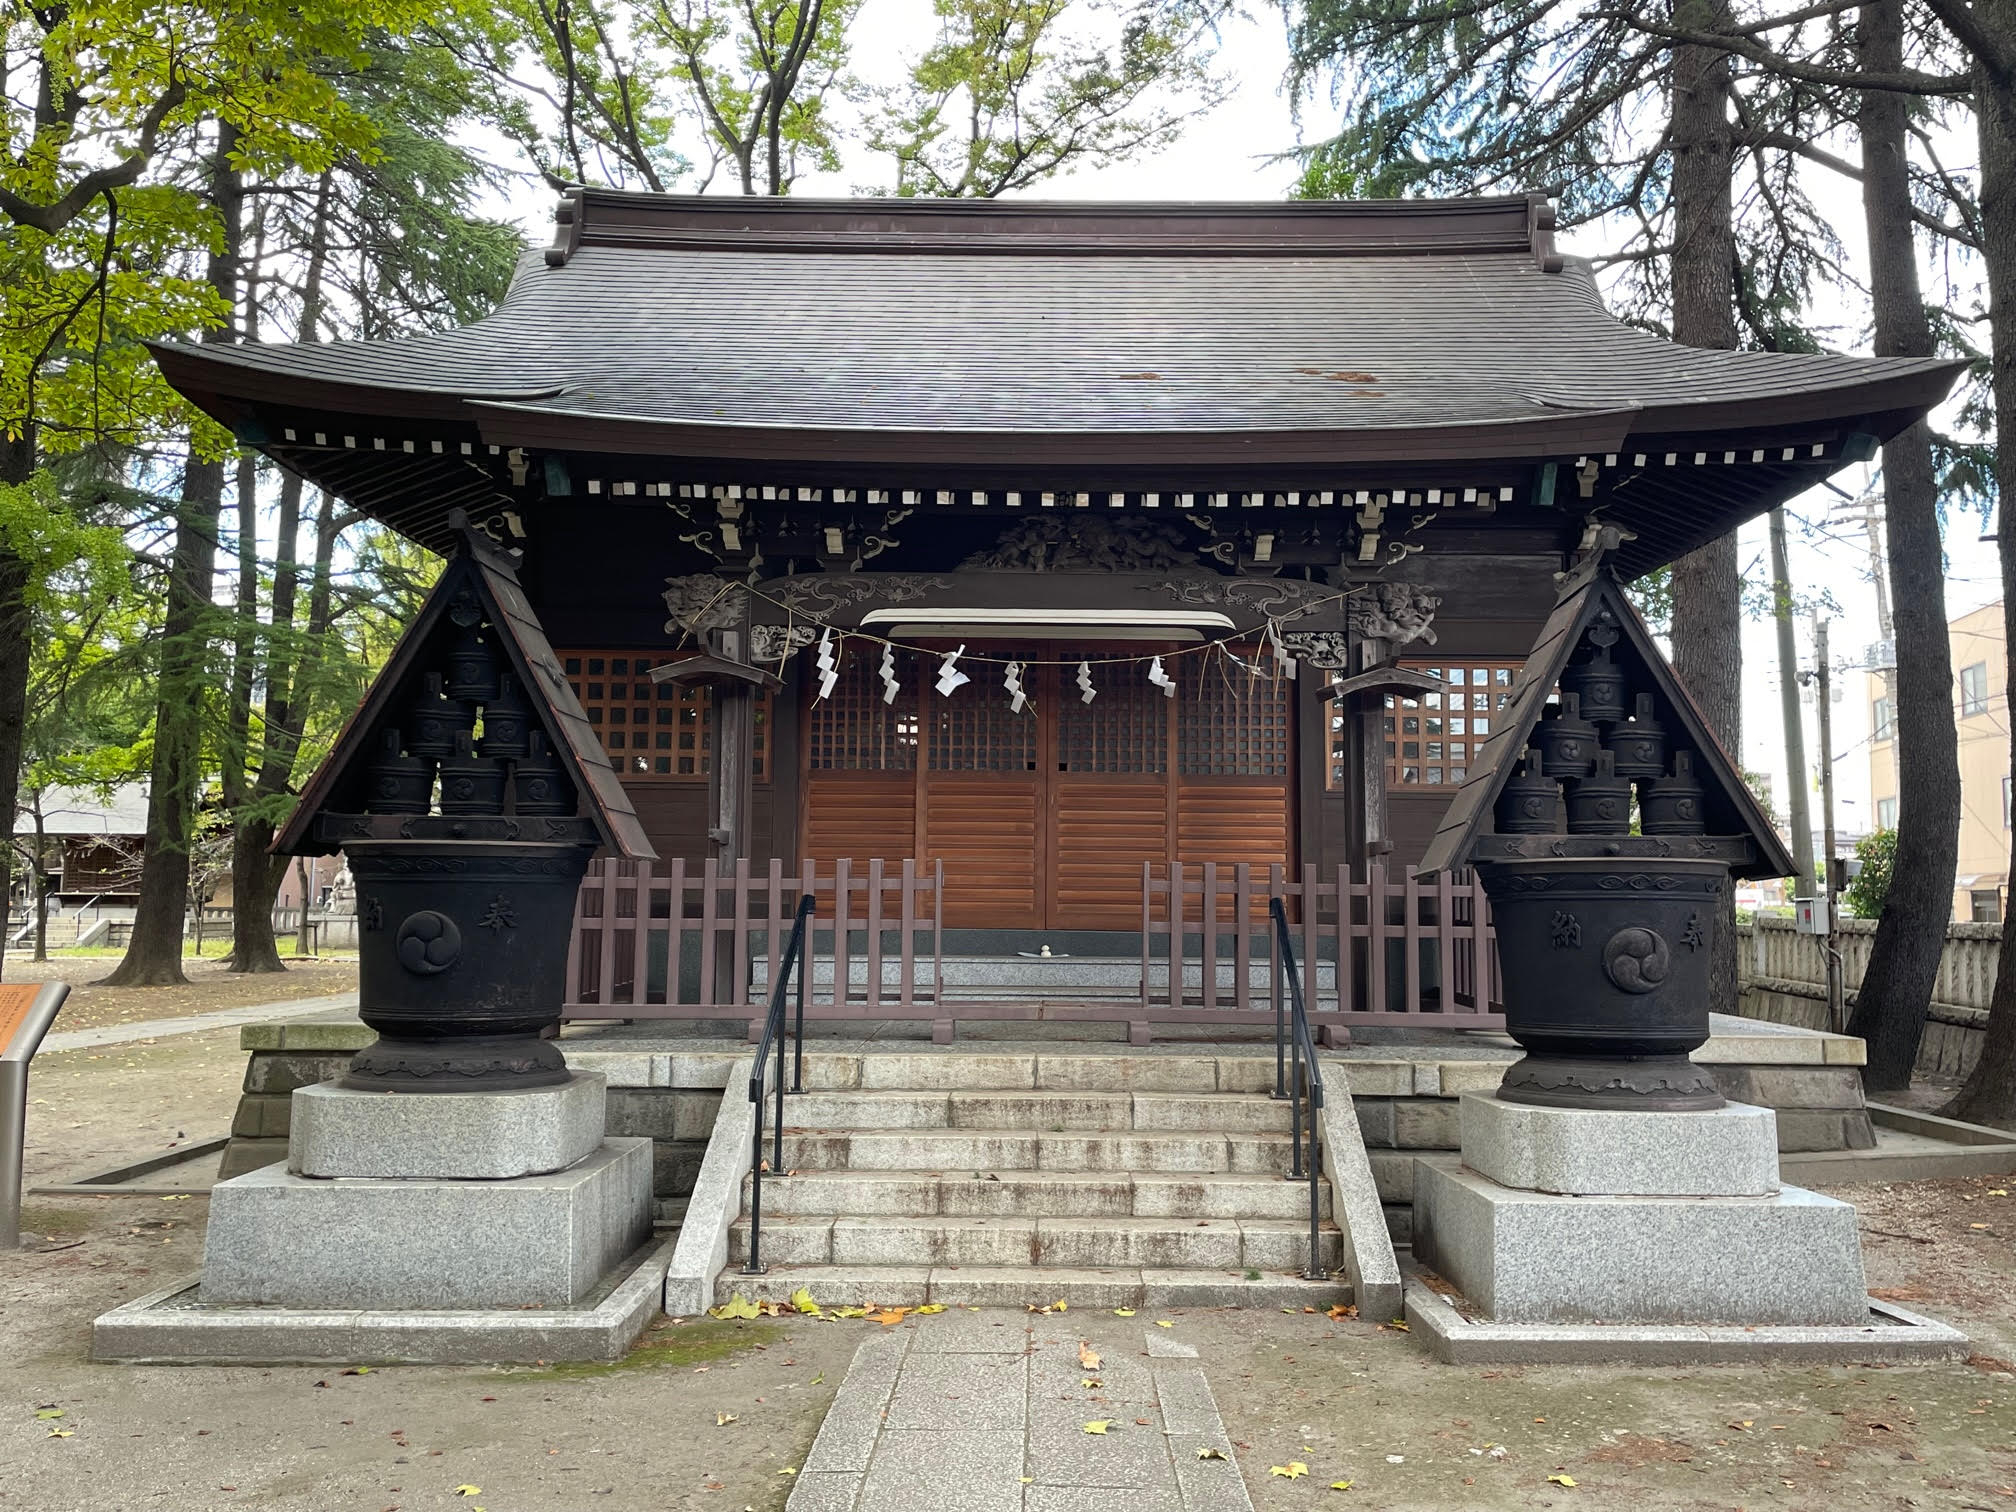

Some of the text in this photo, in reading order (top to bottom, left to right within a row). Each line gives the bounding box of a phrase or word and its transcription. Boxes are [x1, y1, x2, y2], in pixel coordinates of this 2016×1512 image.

[477, 895, 519, 934] 奉
[1552, 910, 1704, 953] 奉 納
